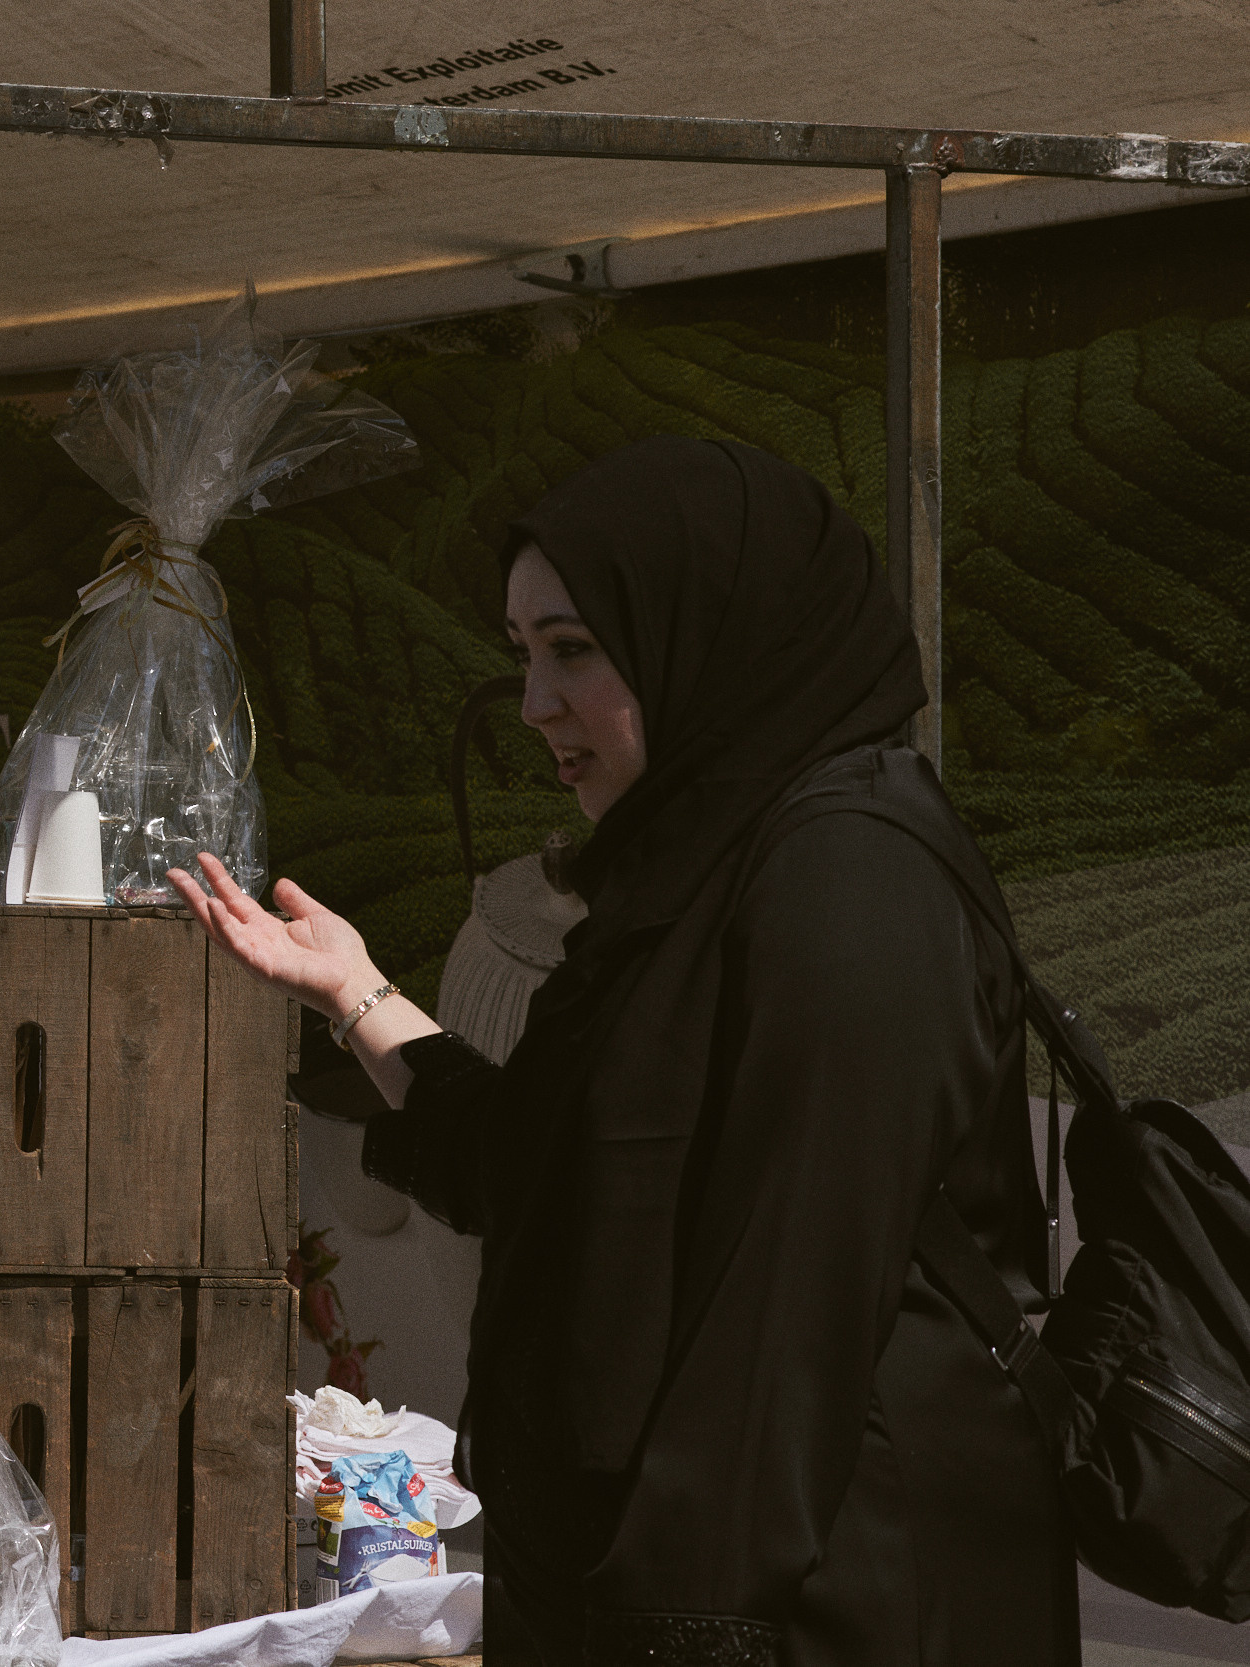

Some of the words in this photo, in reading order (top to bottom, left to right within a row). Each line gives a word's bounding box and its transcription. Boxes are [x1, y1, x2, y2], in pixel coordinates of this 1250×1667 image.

[381, 39, 564, 83] Exploitatie
[414, 80, 546, 106] terdam
[537, 60, 618, 84] B.V.
[361, 1539, 433, 1556] KRISTALSUIKER
